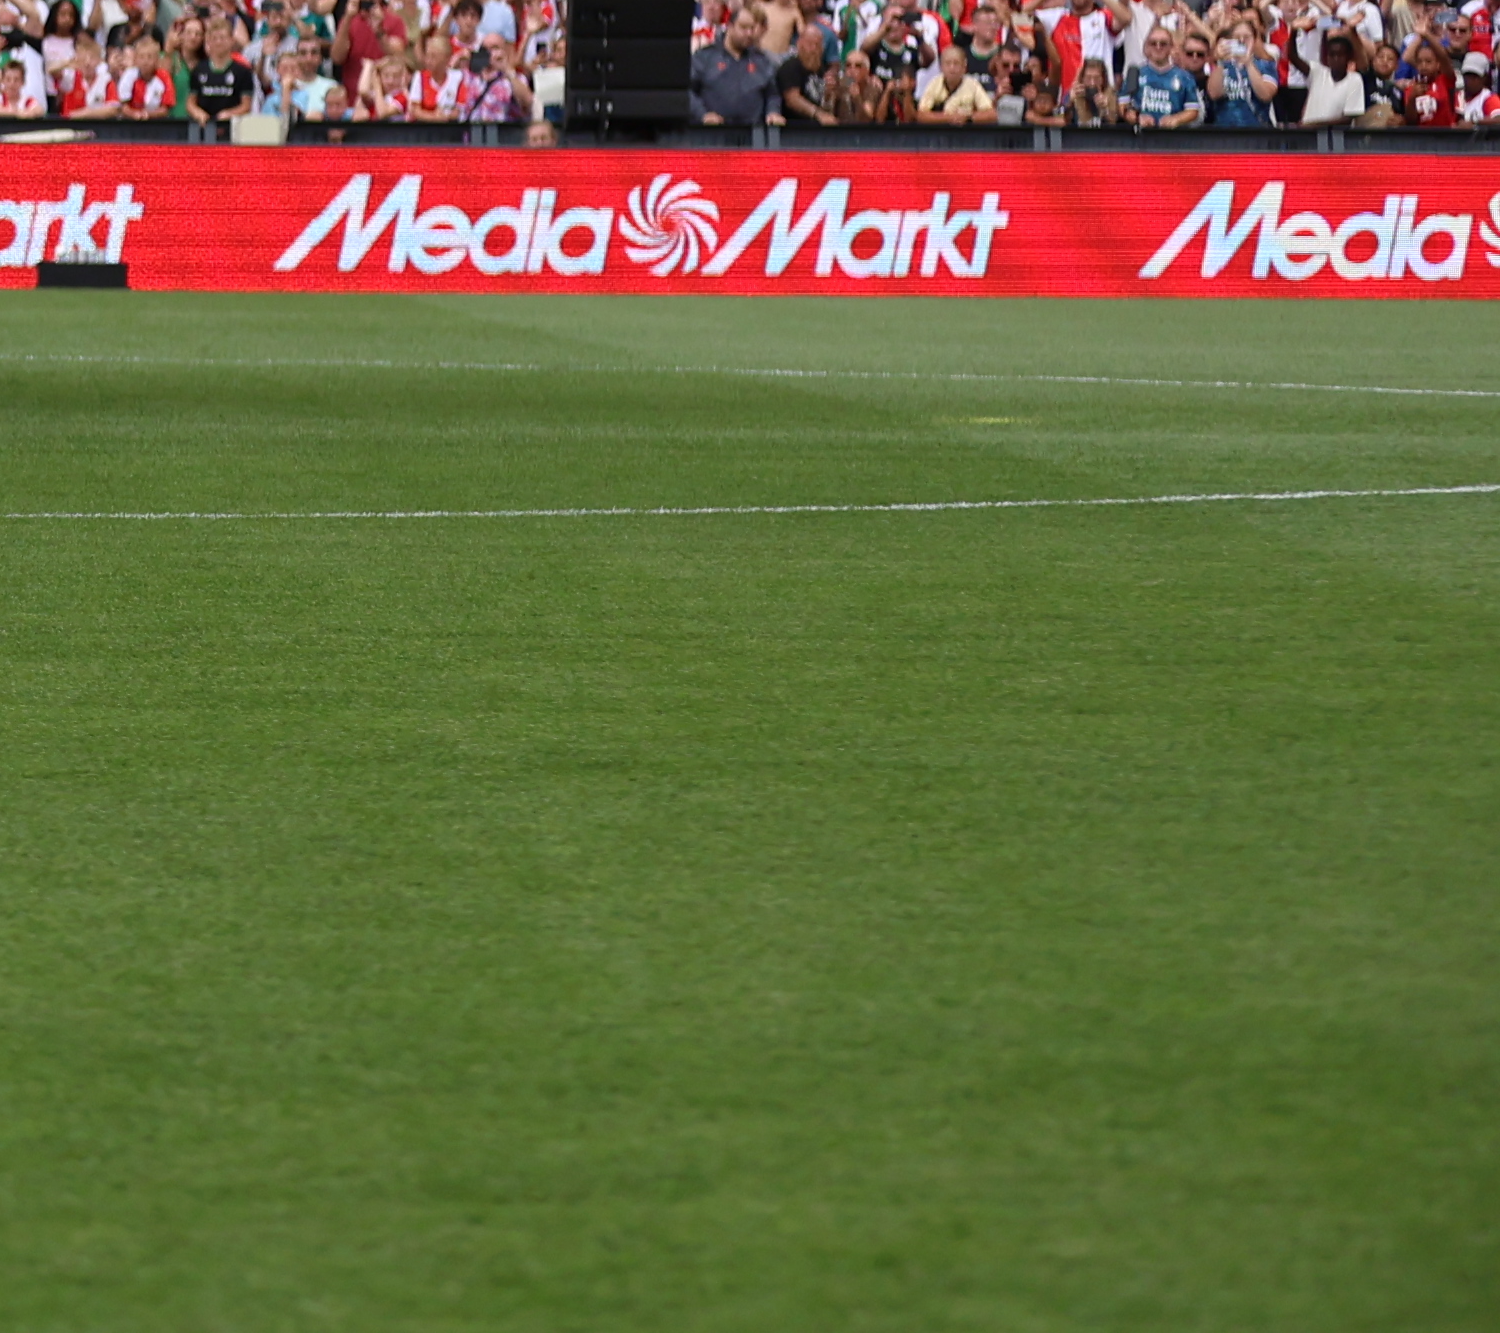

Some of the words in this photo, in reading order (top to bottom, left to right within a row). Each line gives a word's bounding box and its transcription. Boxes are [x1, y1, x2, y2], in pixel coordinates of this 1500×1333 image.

[273, 174, 614, 275] Media
[701, 178, 1008, 279] Markt
[1138, 180, 1473, 281] Media
